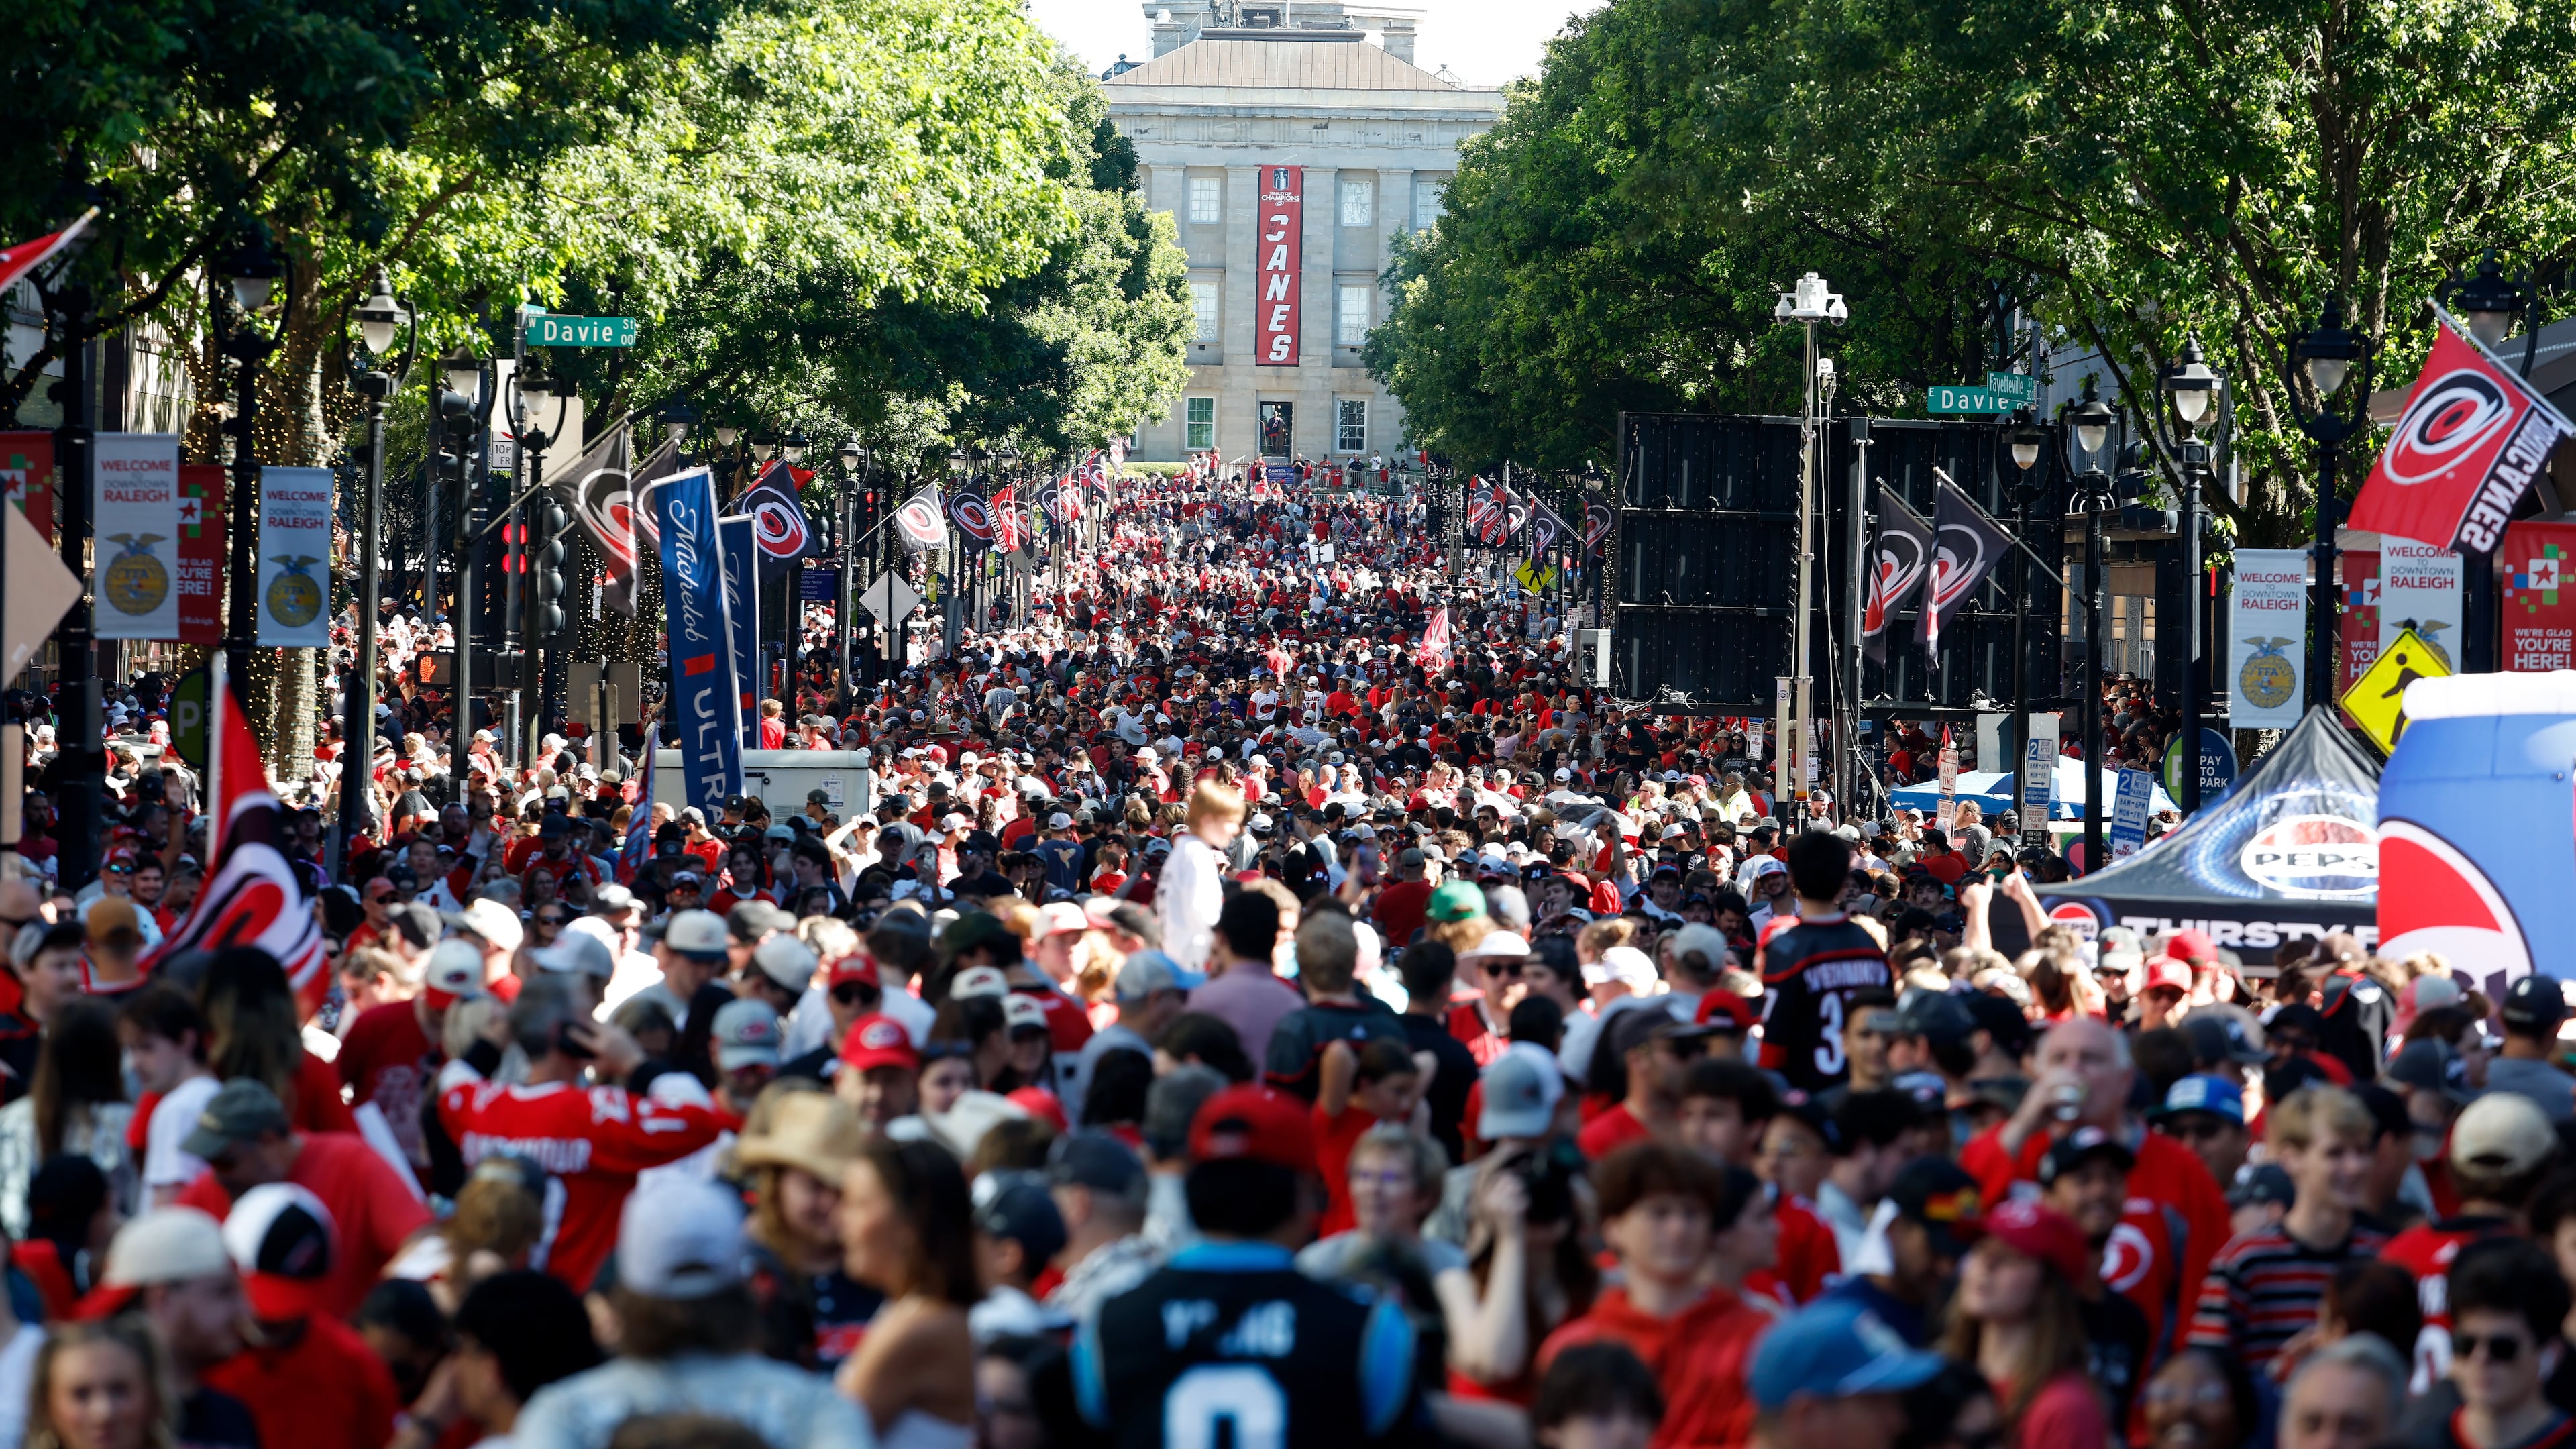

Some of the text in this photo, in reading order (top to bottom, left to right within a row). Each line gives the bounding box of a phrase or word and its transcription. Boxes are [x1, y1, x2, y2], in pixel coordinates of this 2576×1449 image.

[1265, 213, 1293, 362] CANES
[529, 317, 634, 343] W Davie St
[1990, 372, 2033, 398] Fayetteville ST
[1929, 387, 2009, 410] E Davie
[101, 460, 172, 472] WELCOME
[104, 480, 170, 489] DOWNTOWN
[104, 490, 170, 502] RALEIGH
[266, 490, 327, 502] WELCOME
[269, 508, 325, 517] DOWNTOWN
[268, 517, 325, 529] RALEIGH
[2387, 546, 2458, 558] WELCOME
[2416, 558, 2428, 566] TO
[2391, 566, 2455, 576] DOWNTOWN
[2240, 572, 2302, 584] WELCOME
[2390, 576, 2455, 590] RALEIGH
[928, 582, 936, 594] P
[2241, 590, 2299, 599] DOWNTOWN
[2241, 599, 2299, 610] RALEIGH
[1567, 627, 1572, 635] 2
[2515, 628, 2572, 637] WE'RE GLAD
[2350, 641, 2377, 649] WE'RE
[2514, 638, 2571, 652] YOU'RE
[668, 499, 727, 824] Michelob ULTRA
[2514, 653, 2571, 670] HERE!
[2258, 667, 2279, 677] FFA
[177, 700, 201, 737] P
[2029, 741, 2037, 757] 2
[2200, 755, 2222, 765] PAY
[1943, 767, 1953, 775] ANY
[2200, 767, 2215, 777] TO
[1943, 776, 1953, 786] TIME
[2118, 773, 2131, 792] 2
[2134, 780, 2148, 789] METER
[2200, 777, 2229, 788] PARK
[2130, 788, 2149, 797] PARKING
[2123, 843, 2130, 851] NO
[1530, 869, 1542, 879] 24
[2120, 916, 2348, 949] THIRSTY
